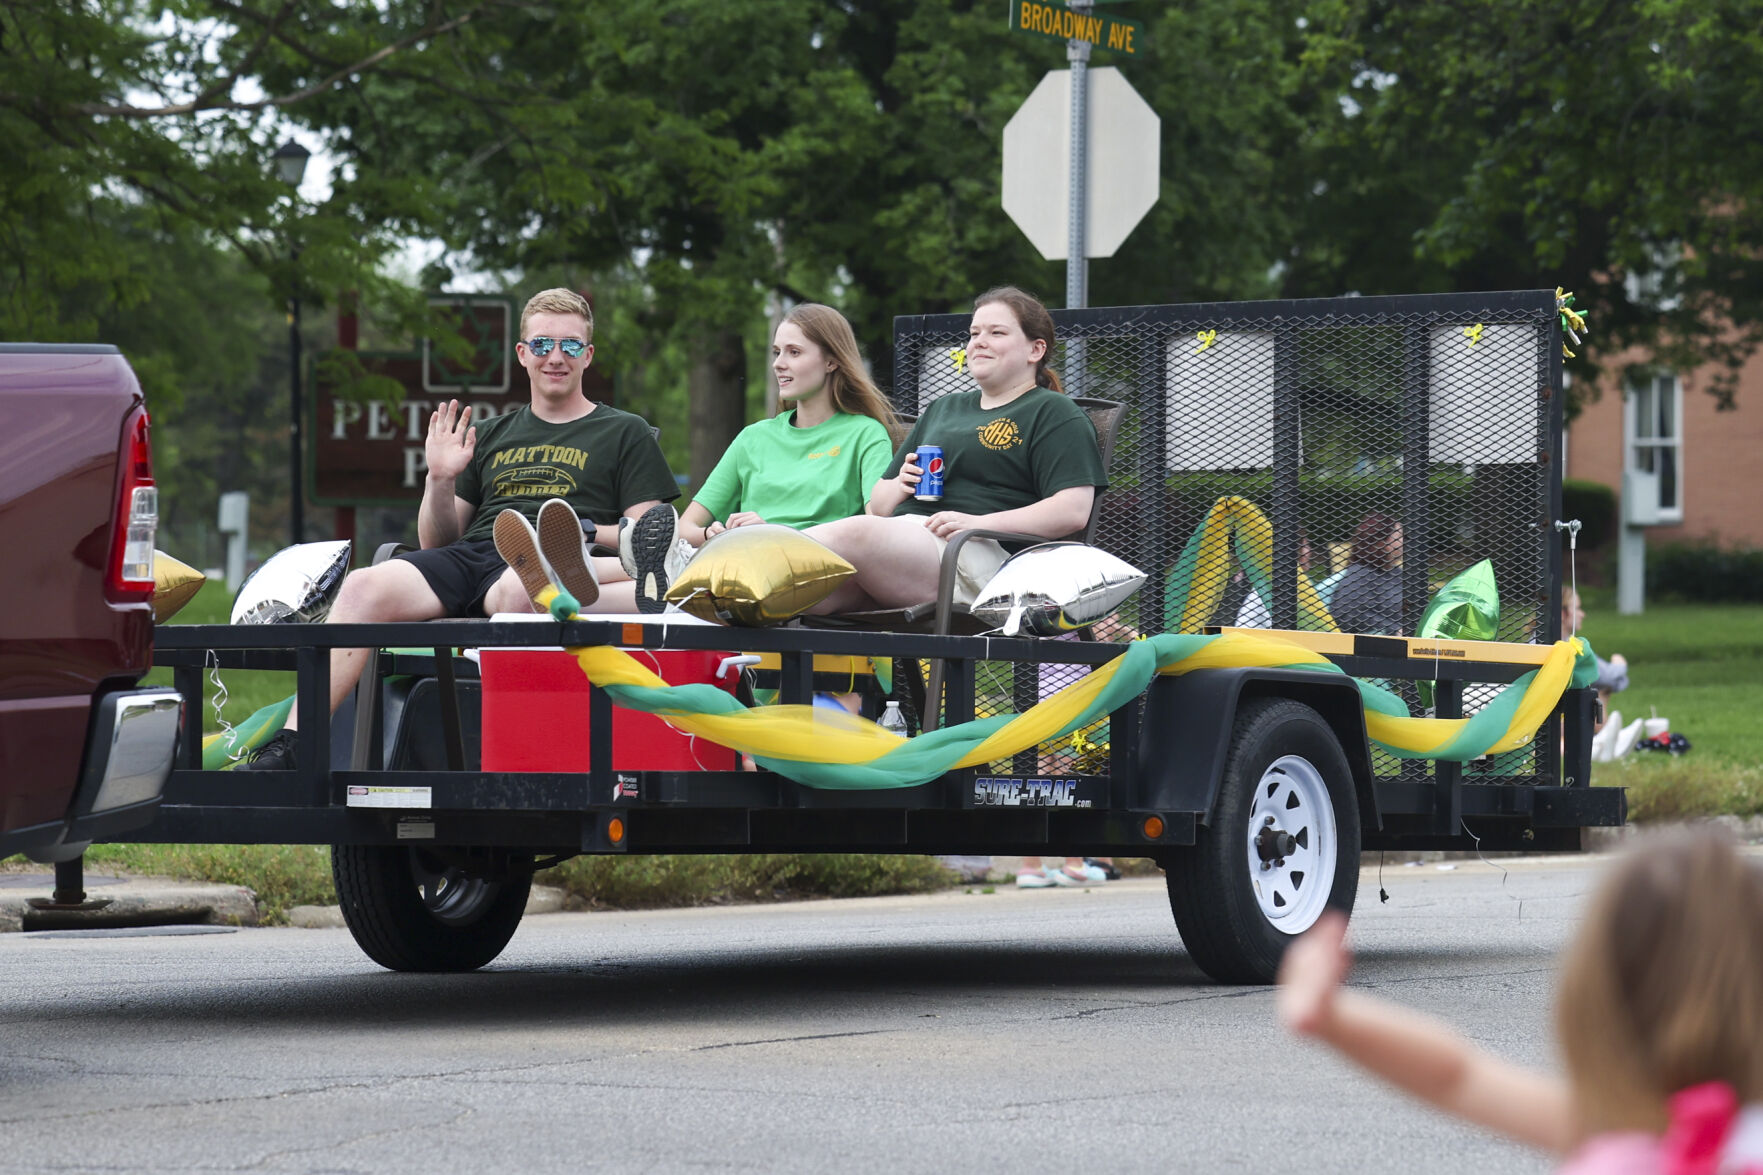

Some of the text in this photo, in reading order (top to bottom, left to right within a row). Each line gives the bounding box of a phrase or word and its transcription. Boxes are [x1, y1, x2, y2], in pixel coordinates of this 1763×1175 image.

[1020, 2, 1136, 54] BROADWAY AVE
[984, 422, 1014, 446] MHS
[491, 444, 589, 471] MATTOON
[974, 777, 1077, 807] SURE-TRAC
